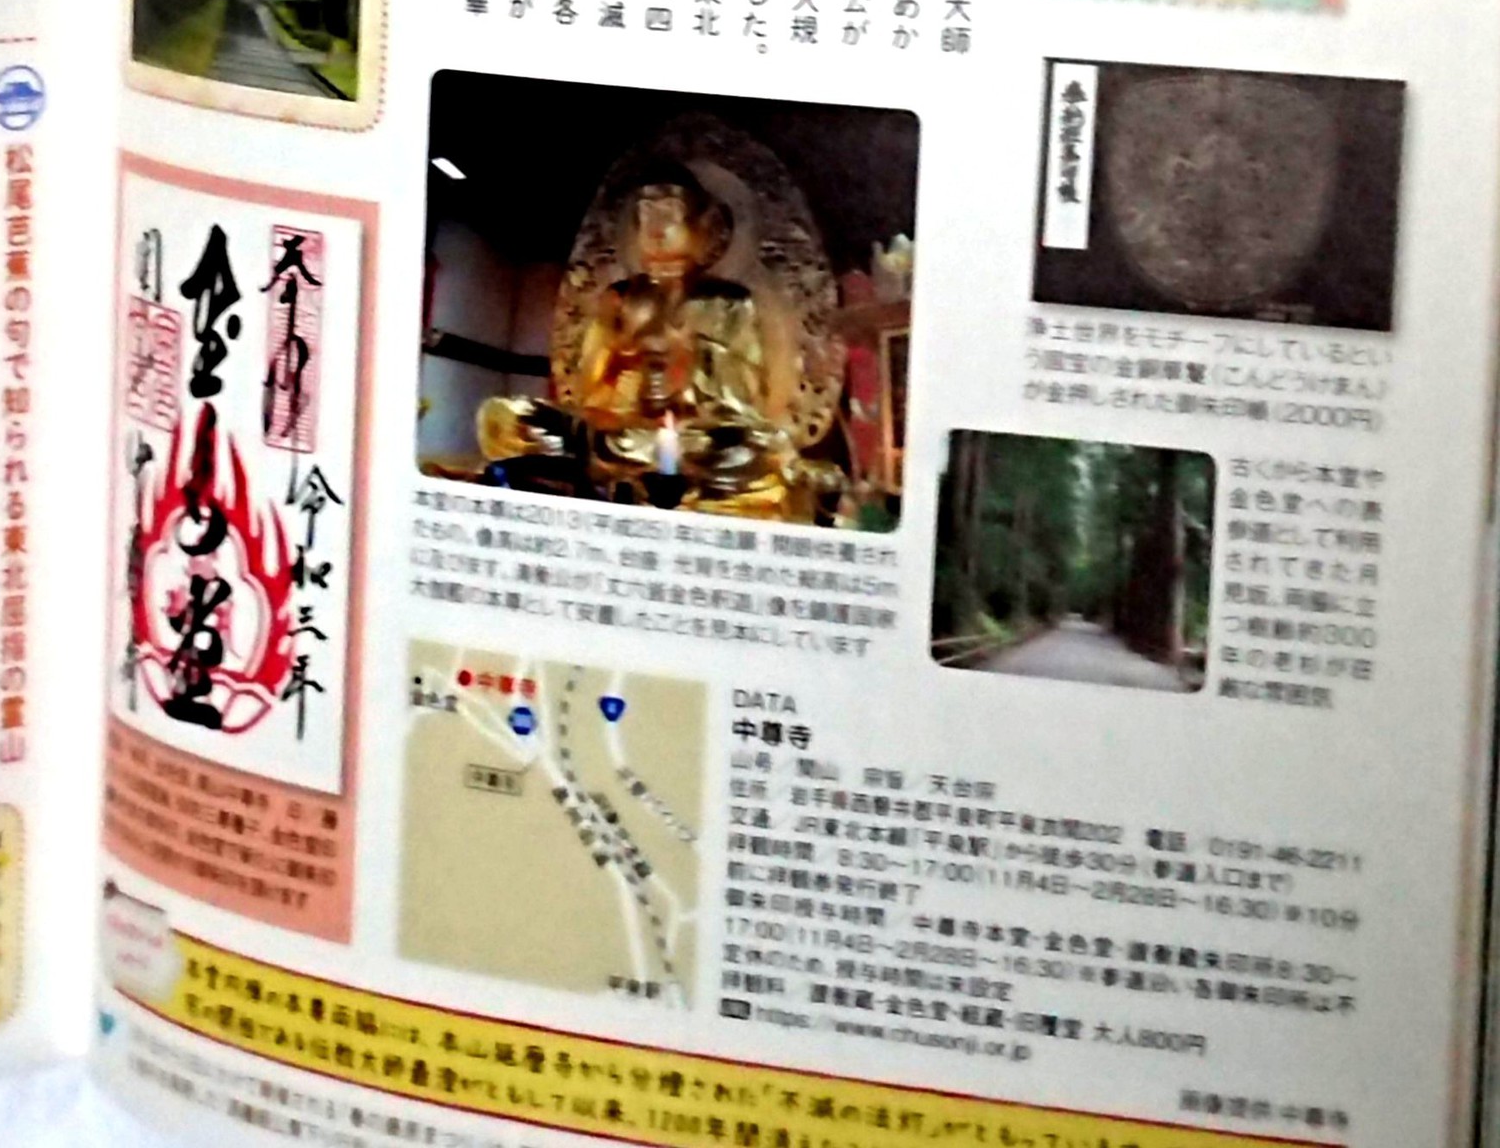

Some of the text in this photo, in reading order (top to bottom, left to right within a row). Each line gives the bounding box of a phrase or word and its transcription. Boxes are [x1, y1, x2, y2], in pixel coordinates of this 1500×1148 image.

[732, 688, 798, 715] DATA
[731, 717, 813, 750] 中尊寺
